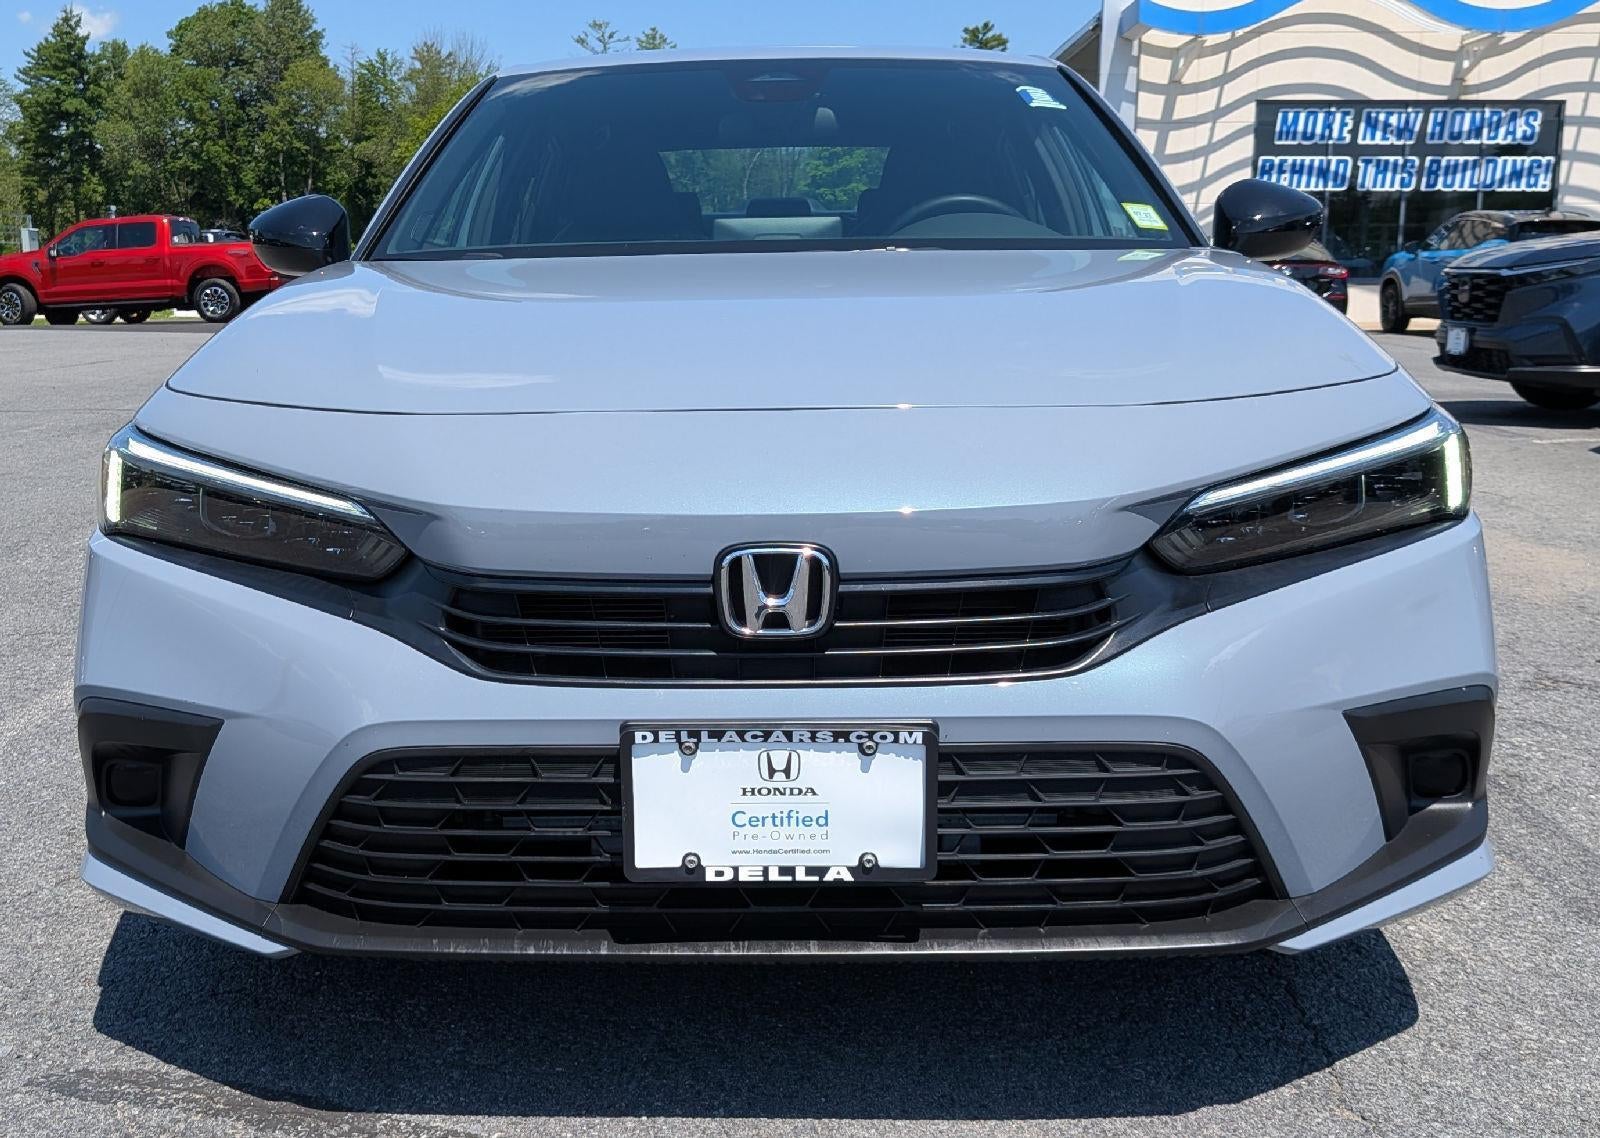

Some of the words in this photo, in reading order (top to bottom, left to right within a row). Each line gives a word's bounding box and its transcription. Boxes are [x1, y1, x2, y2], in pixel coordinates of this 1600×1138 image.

[1274, 107, 1355, 145] MORE
[1357, 107, 1424, 145] NEW
[1425, 107, 1543, 145] HONDAS
[1257, 156, 1353, 191] BEHIND
[1356, 156, 1420, 191] THIS
[1420, 156, 1556, 192] BUILDING!
[634, 730, 923, 744] DELLACARS.COM
[740, 787, 819, 796] HONDA
[731, 809, 829, 827] Certified
[732, 830, 829, 840] Pre-Owned
[705, 865, 855, 882] DELLA
